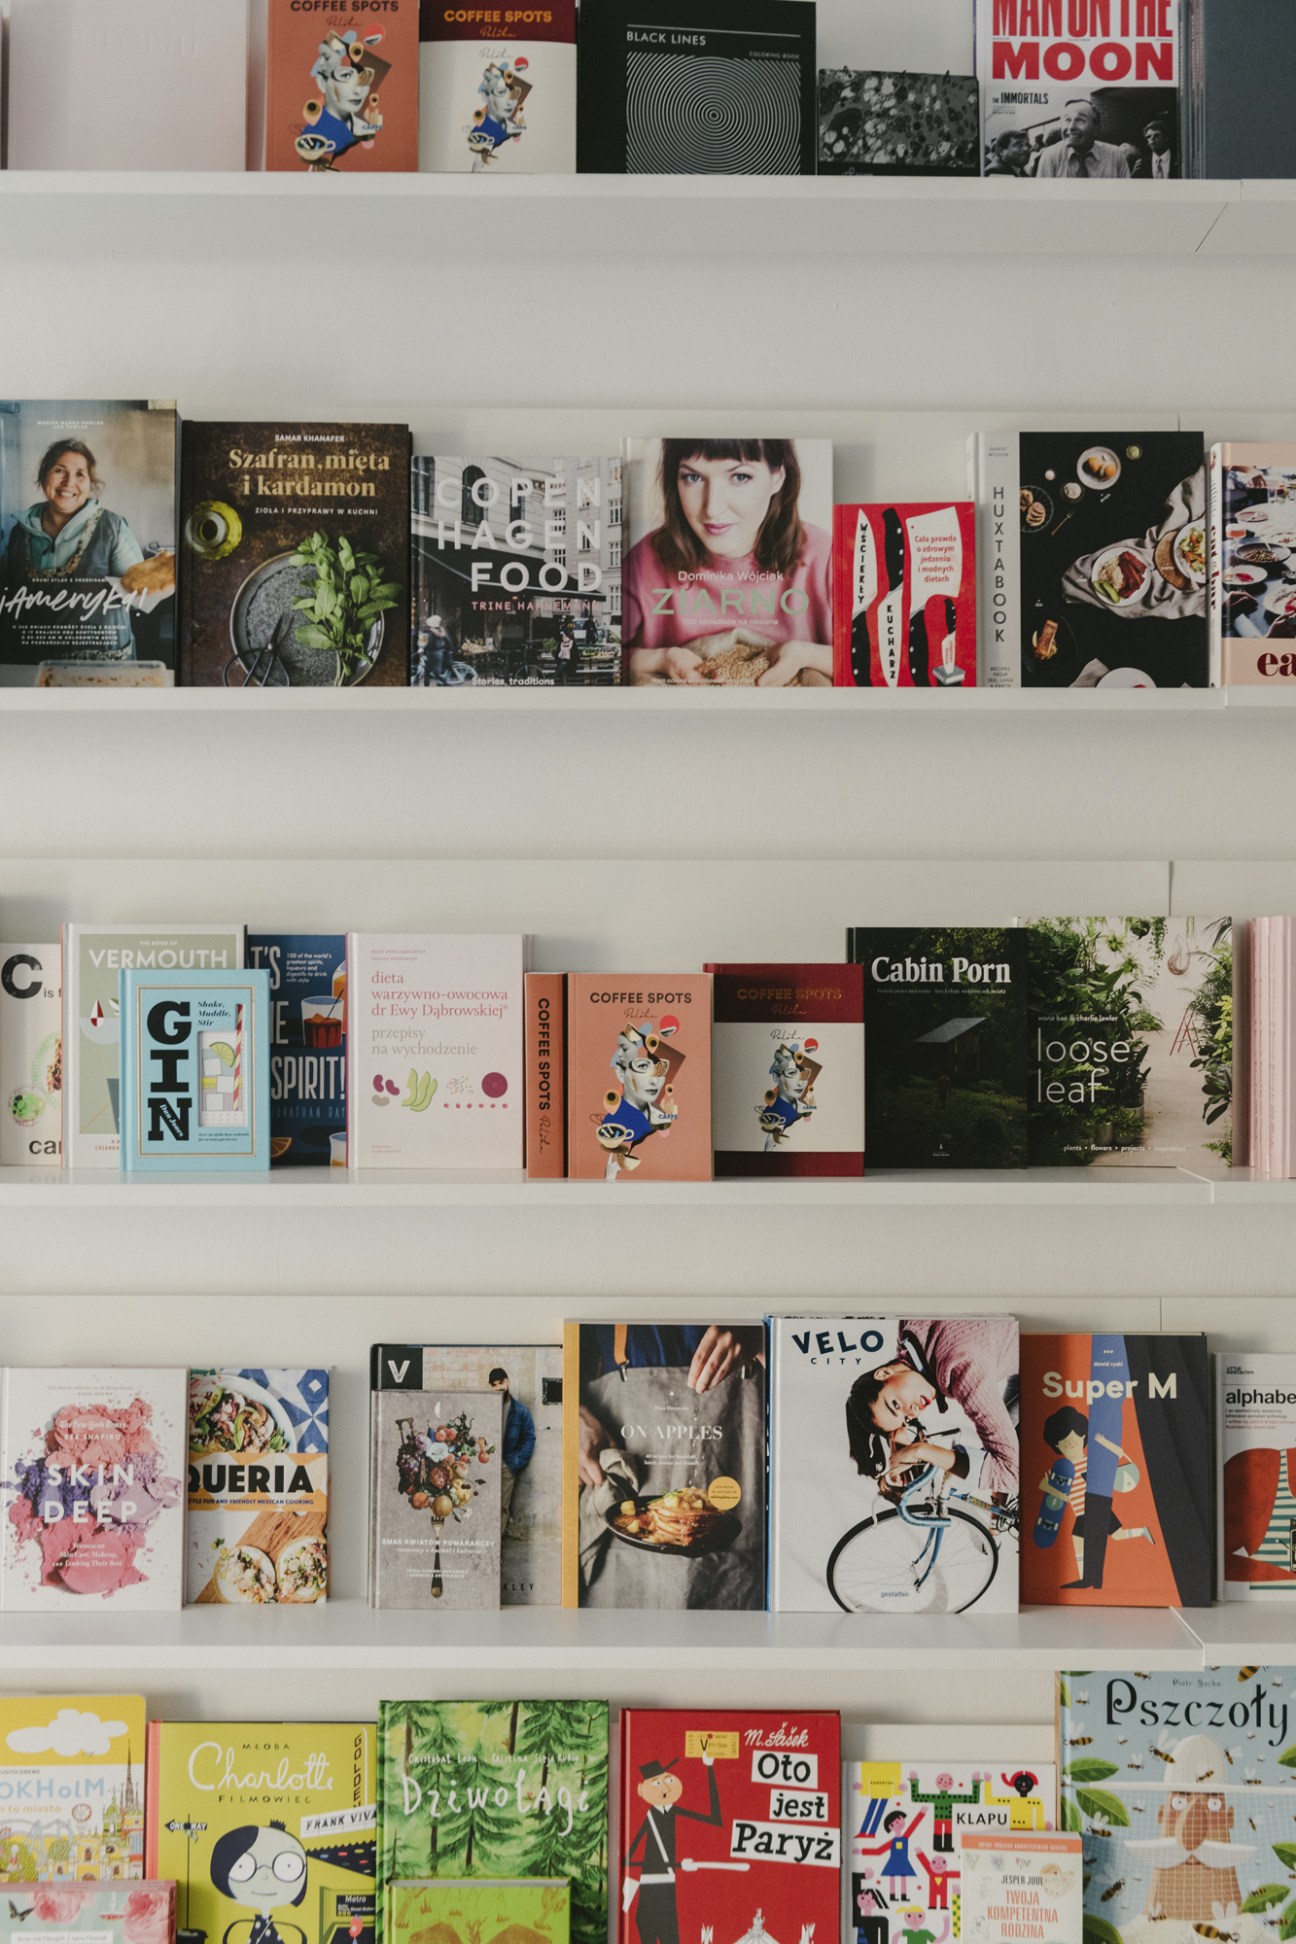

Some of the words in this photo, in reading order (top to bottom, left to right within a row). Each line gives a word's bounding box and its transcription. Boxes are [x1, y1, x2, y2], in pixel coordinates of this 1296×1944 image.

[290, 0, 347, 11] COFFEE
[351, 0, 399, 11] SPOTS
[444, 10, 500, 22] COFFEE
[504, 10, 552, 23] SPOTS
[626, 31, 666, 43] BLACK
[671, 34, 706, 46] LINES
[992, 42, 1173, 81] MOON
[1001, 92, 1048, 104] IMMORTALS
[275, 434, 301, 442] SAMAR
[304, 435, 345, 443] KHANAFER
[229, 449, 322, 470] Szafran,
[325, 449, 390, 475] mięta
[243, 476, 250, 496] i
[257, 475, 376, 497] kardamon
[437, 477, 600, 508] COPEN
[437, 519, 600, 550] HAGEN
[931, 535, 956, 543] prawda
[922, 545, 955, 554] zdrowym
[920, 555, 951, 565] jedzeniu
[993, 486, 1007, 643] HUXTABOOK
[471, 561, 602, 592] FOOD
[678, 571, 733, 581] Dominika
[737, 570, 783, 582] Wójciak
[922, 564, 954, 574] modnych
[472, 601, 512, 610] TRINE
[652, 587, 809, 616] ZIARNO
[887, 604, 897, 679] KUCHARZ
[509, 676, 555, 685] traditions
[89, 950, 227, 968] VERMOUTH
[1, 954, 43, 999] C
[871, 956, 944, 983] Cabin
[951, 957, 1011, 983] Porn
[371, 971, 404, 984] dieta
[44, 987, 54, 998] is
[371, 990, 508, 1003] warzywno-owocowa
[590, 992, 643, 1004] COFFEE
[647, 992, 692, 1004] SPOTS
[737, 988, 792, 999] COFFEE
[795, 988, 842, 1000] SPOTS
[198, 1010, 231, 1018] Muddle,
[371, 1004, 386, 1016] dr
[390, 1004, 418, 1020] Ewy
[198, 1019, 214, 1027] Stir
[538, 998, 550, 1057] COFFEE
[372, 1026, 426, 1041] przepisy
[372, 1045, 387, 1055] na
[391, 1042, 477, 1057] wychodzenie
[1037, 1027, 1131, 1063] loose
[147, 1001, 192, 1141] GIN
[271, 1056, 345, 1100] SPIRIT!
[539, 1063, 550, 1111] SPOTS
[1037, 1067, 1106, 1103] leaf
[29, 1140, 61, 1155] ca
[1063, 1144, 1082, 1152] plants
[1090, 1143, 1112, 1151] flowers
[1120, 1144, 1145, 1152] projects
[792, 1330, 884, 1355] VELO
[388, 1360, 410, 1383] V
[1042, 1371, 1138, 1405] Super
[1148, 1372, 1177, 1399] M
[620, 1425, 647, 1439] ON
[652, 1425, 723, 1440] APPLES
[47, 1464, 134, 1487] SKIN
[44, 1501, 138, 1523] DEEP
[1106, 1678, 1288, 1747] Pszczoły
[188, 1741, 333, 1791] Charlotte
[757, 1753, 812, 1783] Oto
[218, 1795, 311, 1804] FILMOWIEC
[773, 1793, 825, 1819] jest
[8, 1804, 19, 1813] to
[23, 1804, 61, 1813] miasto
[306, 1816, 344, 1831] FRANK
[956, 1813, 1008, 1825] KLAPU
[732, 1823, 834, 1863] Paryż
[1001, 1875, 1025, 1885] JESPER
[1027, 1876, 1043, 1886] JUUL
[345, 1895, 367, 1903] Metro
[1006, 1890, 1040, 1905] TWOJA
[987, 1906, 1058, 1923] KOMPETENTNA
[1001, 1922, 1044, 1939] RODZINA
